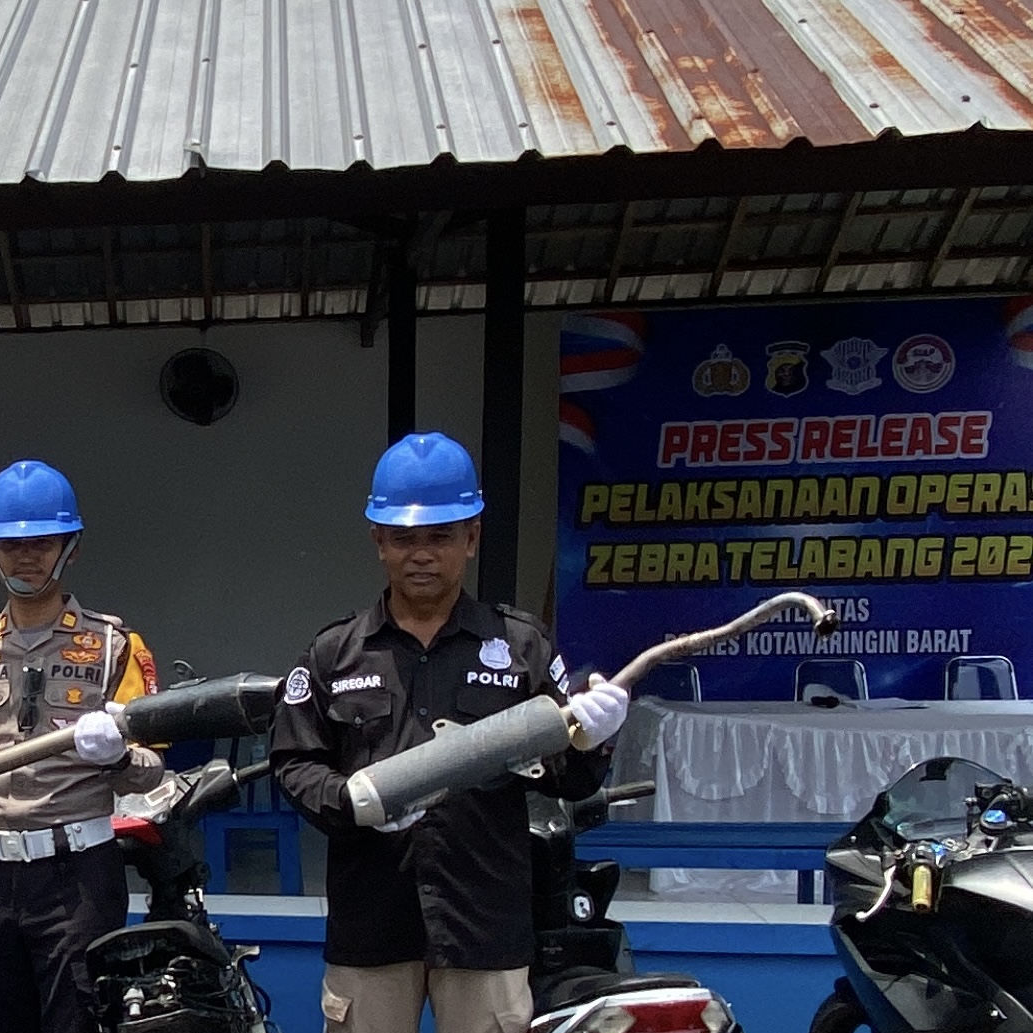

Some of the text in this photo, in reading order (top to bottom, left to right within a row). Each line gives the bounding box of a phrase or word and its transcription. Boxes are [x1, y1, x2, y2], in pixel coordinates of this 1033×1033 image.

[659, 412, 992, 466] PRESS RELEASE
[581, 472, 1033, 523] PELAKSANAAN OPERA
[587, 541, 719, 583] ZEBRA
[726, 537, 945, 581] TELABANG
[746, 630, 899, 655] KOTAWARINGIN
[907, 629, 972, 653] BARAT
[51, 664, 101, 683] POLRI
[331, 675, 382, 694] SIREGAR
[467, 671, 519, 688] POLRI
